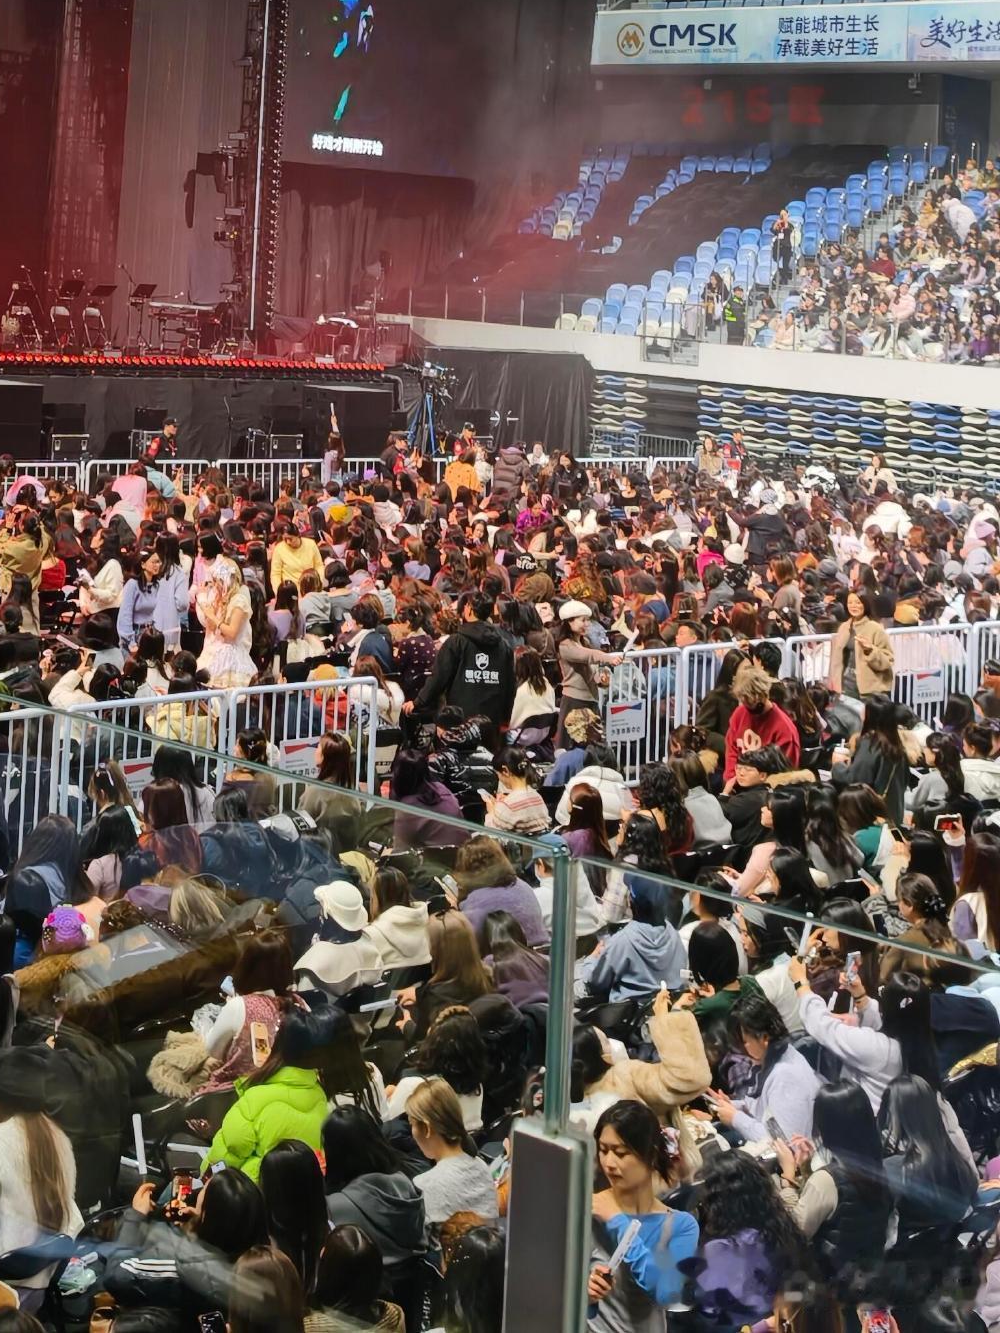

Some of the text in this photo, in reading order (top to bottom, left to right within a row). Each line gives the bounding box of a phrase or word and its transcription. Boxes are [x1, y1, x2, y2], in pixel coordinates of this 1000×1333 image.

[649, 23, 738, 47] CMSK
[777, 14, 880, 35] 赋能城市生长
[776, 37, 880, 57] 承载美好生活
